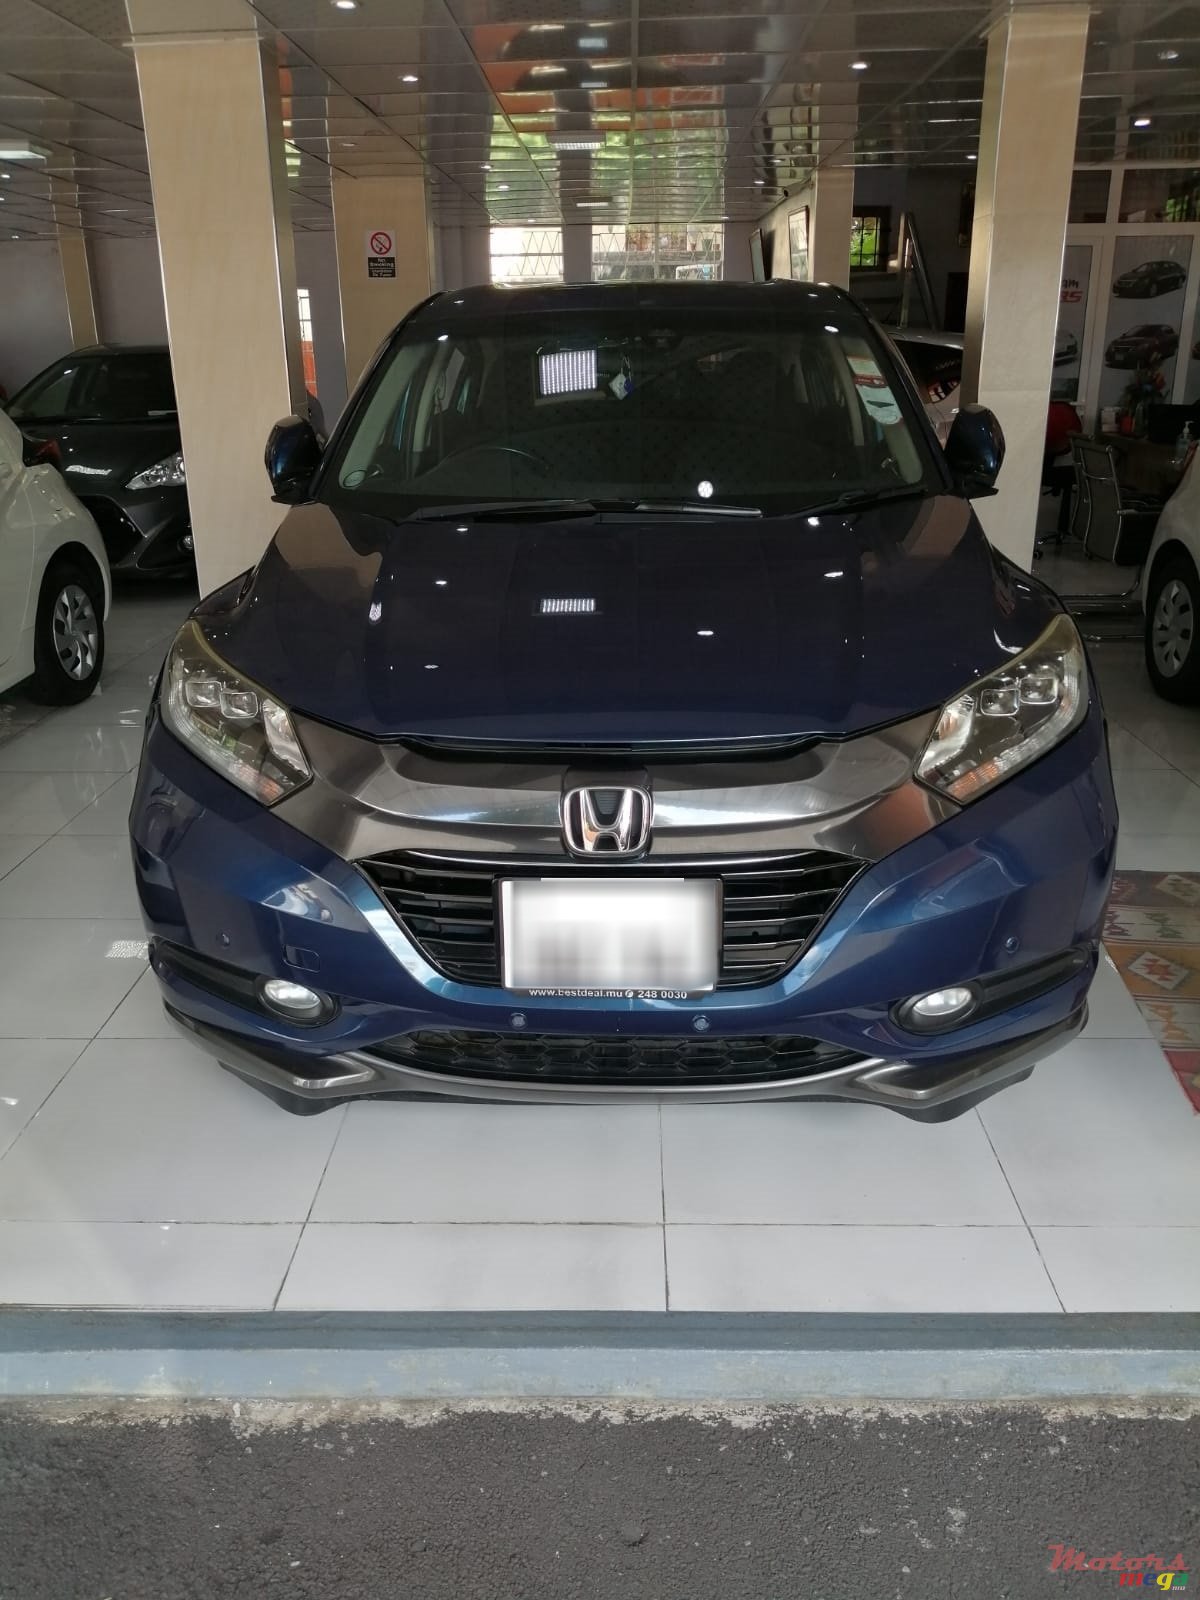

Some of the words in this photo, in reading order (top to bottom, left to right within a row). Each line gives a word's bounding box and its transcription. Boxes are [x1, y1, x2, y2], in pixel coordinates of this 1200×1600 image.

[528, 988, 624, 998] www.bestdeal.mu
[637, 990, 658, 999] 248
[660, 990, 688, 999] 0030
